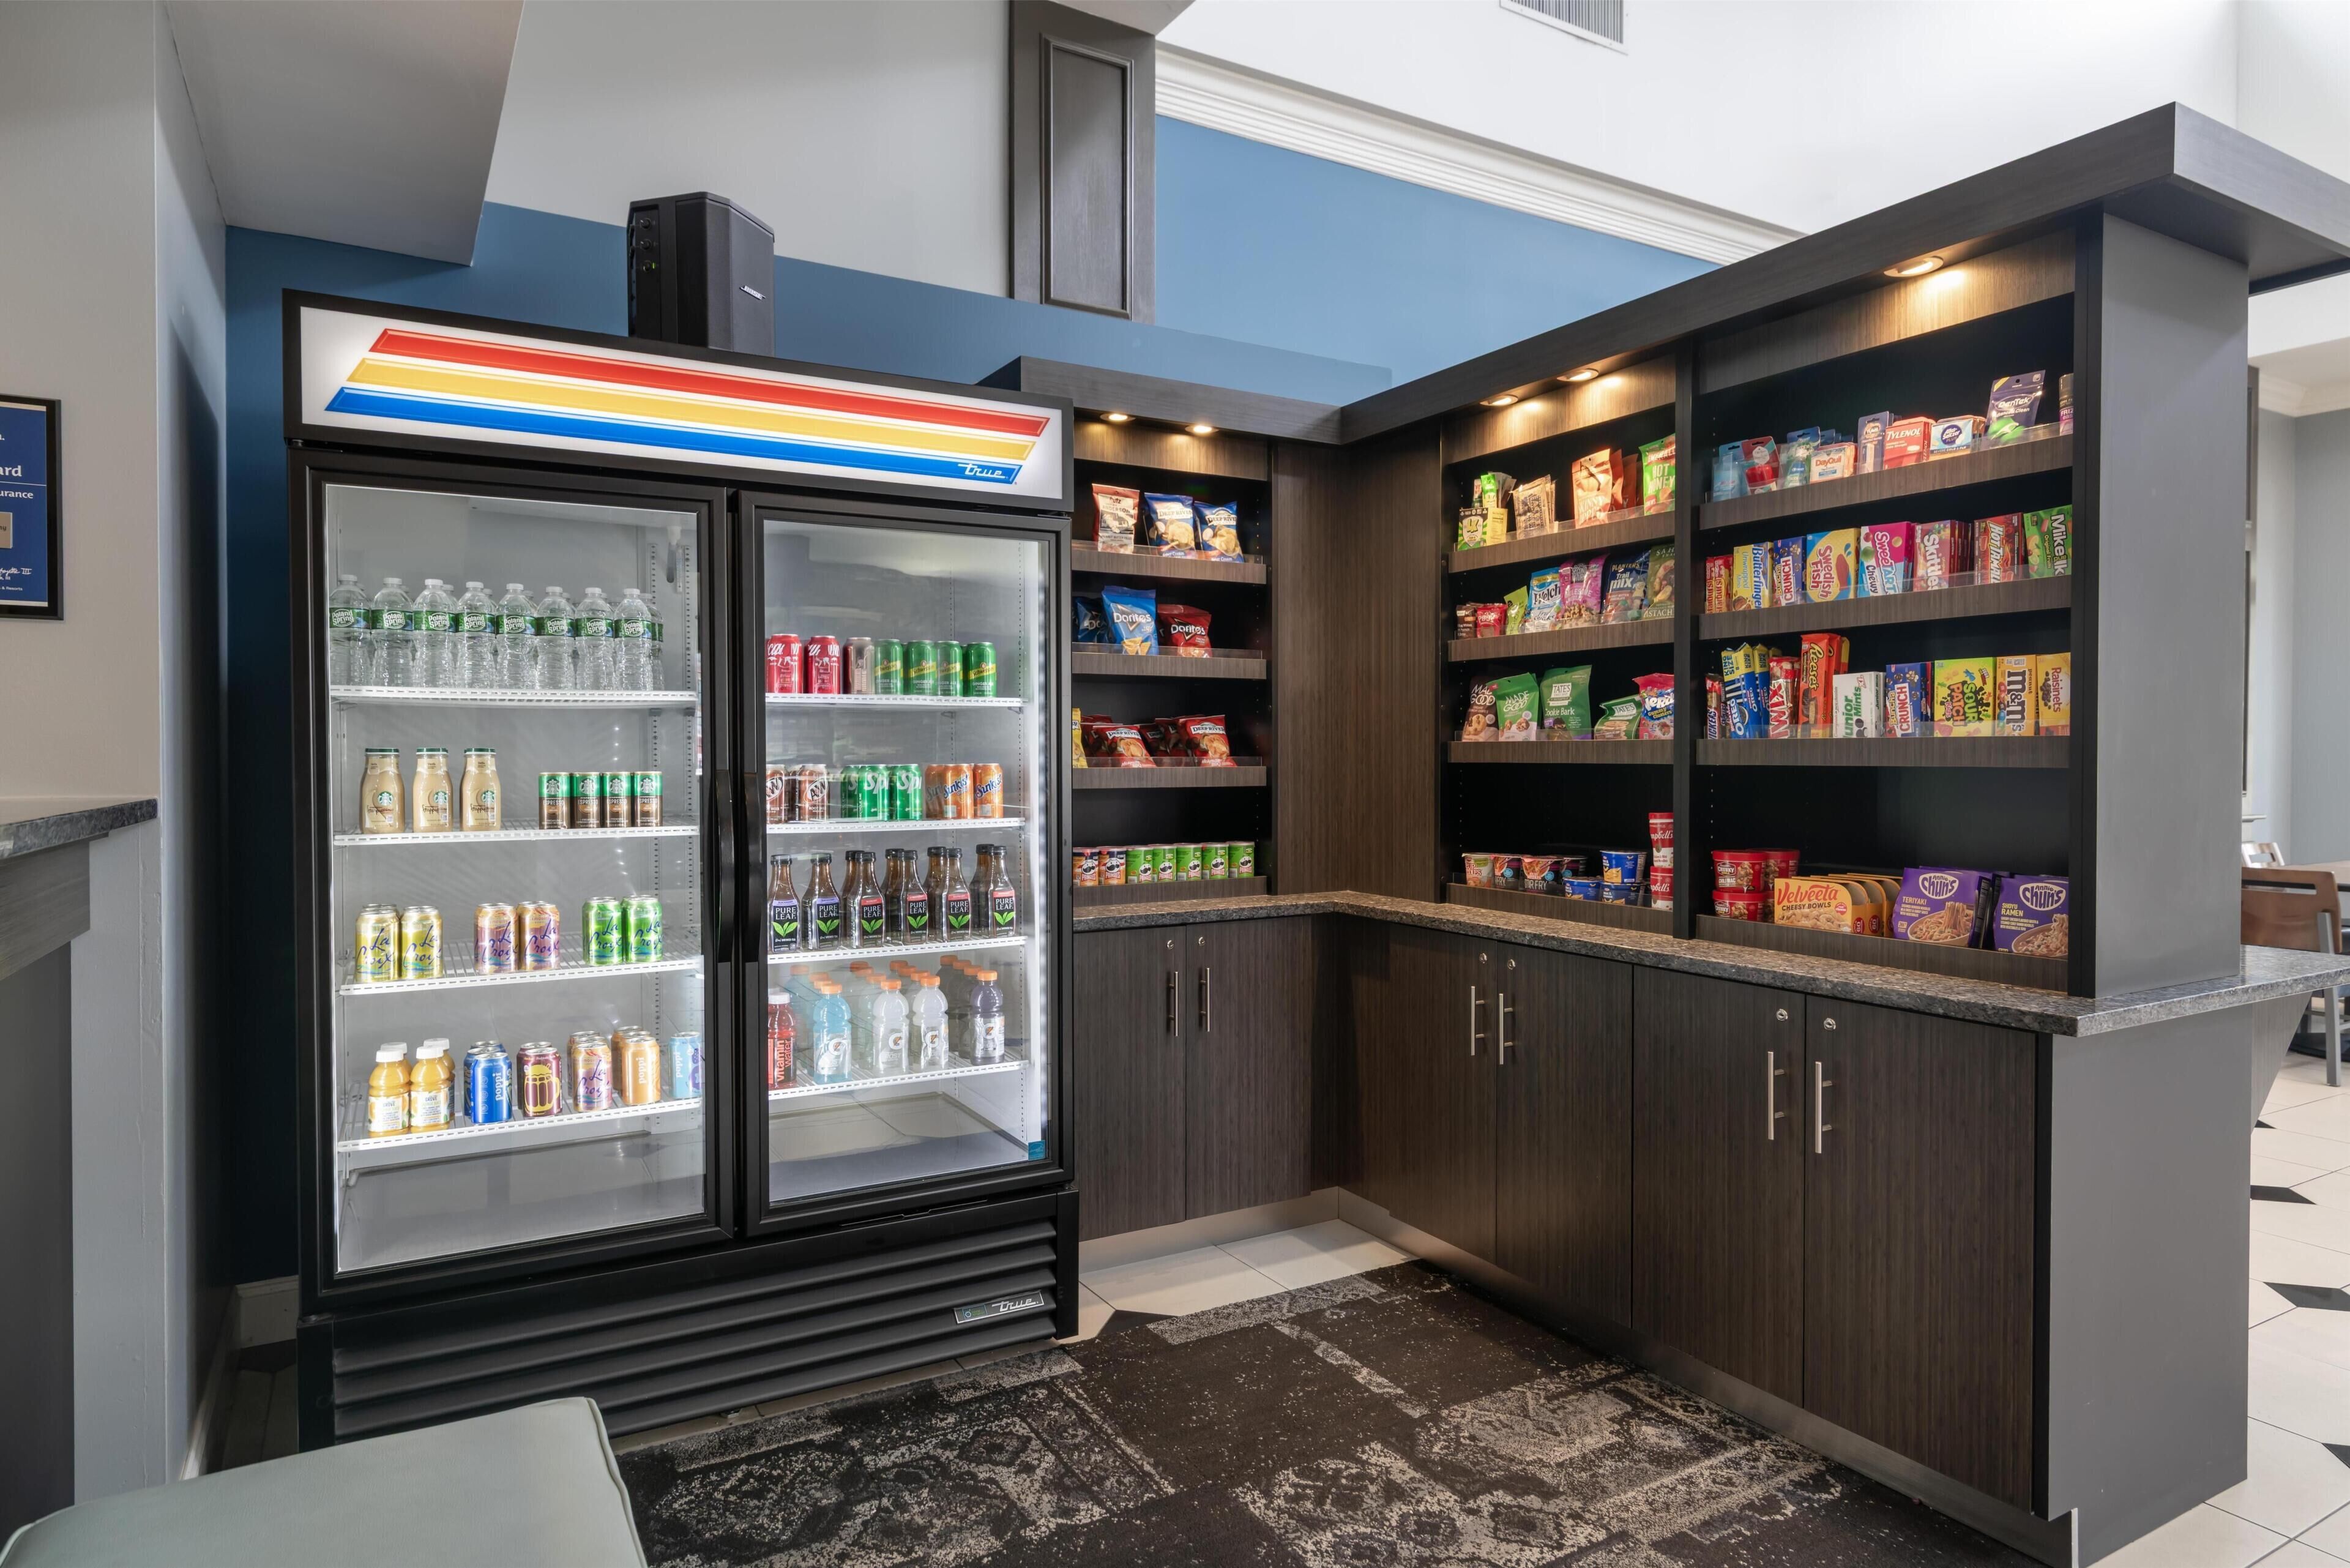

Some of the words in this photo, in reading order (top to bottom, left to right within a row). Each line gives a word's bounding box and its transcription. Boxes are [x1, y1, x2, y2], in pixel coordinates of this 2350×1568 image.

[739, 285, 766, 300] BOSE
[1998, 397, 2031, 408] DenTek
[1887, 428, 1921, 440] TYLENOL
[1942, 431, 1960, 439] Seltzer
[1652, 464, 1669, 477] HOT
[1816, 456, 1841, 466] DayQuil
[2051, 514, 2067, 556] Mike
[1612, 562, 1640, 572] PLANTERS
[1811, 560, 1822, 589] Fish
[1818, 545, 1835, 599] Swedish
[1610, 578, 1634, 589] mix
[1782, 559, 1793, 601] CRUNCH
[1866, 565, 1878, 594] Chewy
[332, 609, 353, 621] Poland
[332, 616, 354, 625] Spring
[382, 613, 405, 621] Poland
[384, 617, 405, 627] Spring
[428, 614, 449, 622] Poland
[429, 619, 450, 628] Spring
[464, 614, 485, 624] Poland
[464, 620, 485, 629] Spring
[504, 616, 524, 625] Poland
[547, 619, 566, 627] Poland
[587, 619, 605, 628] Poland
[1113, 612, 1152, 623] Doritos
[504, 622, 524, 631] Spring
[548, 624, 567, 633] Spring
[588, 625, 606, 634] Spring
[624, 621, 643, 630] Poland
[624, 626, 644, 635] Spring
[1171, 624, 1206, 635] Doritos
[1808, 642, 1824, 690] Reese's
[1506, 690, 1529, 704] MADE
[1553, 684, 1570, 692] TATE'S
[2051, 667, 2062, 712] Raisinets
[1471, 694, 1495, 706] GOOD
[1504, 700, 1528, 711] GOOD
[1614, 704, 1635, 713] TATE'S
[1853, 686, 1862, 717] Mints
[1899, 686, 1911, 732] CRUNCH
[1949, 682, 1966, 726] PATCH
[1963, 682, 1979, 723] SOUR
[2006, 670, 2027, 732] m&m's
[1731, 698, 1744, 735] OREO
[944, 774, 969, 799] Sunkist
[975, 774, 1002, 798] Sunkist
[1524, 879, 1534, 888] STIR
[1535, 881, 1548, 890] FRY
[1777, 882, 1838, 905] Velveeta
[1921, 877, 1957, 897] Chun's
[1903, 896, 1927, 905] TERIYAKI
[2021, 887, 2062, 909] Chun's
[498, 920, 515, 943] La
[540, 919, 557, 940] La
[602, 916, 619, 936] La
[646, 912, 661, 932] La
[370, 928, 390, 951] La
[419, 925, 438, 947] La
[588, 931, 621, 956] Croix
[631, 929, 663, 952] Croix
[403, 943, 441, 968] Croix
[482, 938, 518, 963] Croix
[525, 935, 559, 960] Croix
[357, 946, 395, 970] Croix
[589, 1059, 606, 1081] La
[636, 1058, 646, 1085] poppi
[492, 1072, 504, 1101] poppi
[577, 1077, 610, 1097] Croix
